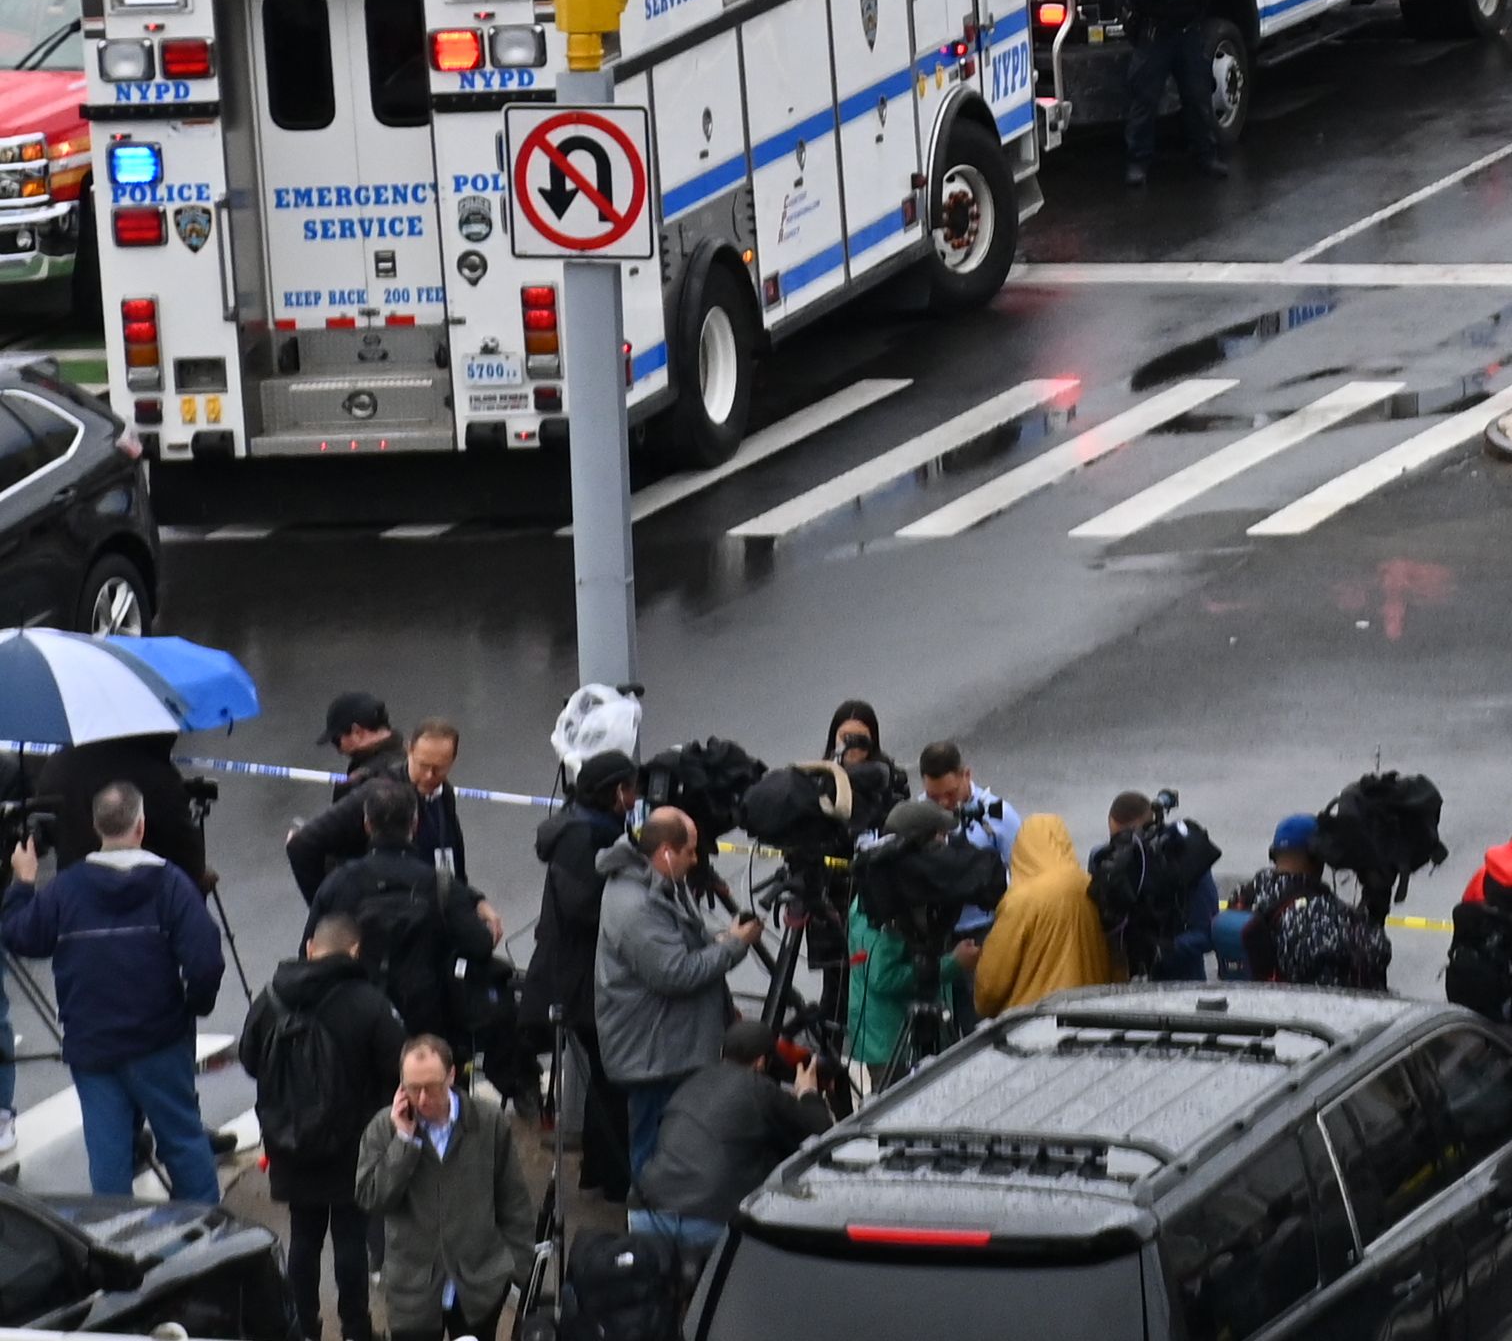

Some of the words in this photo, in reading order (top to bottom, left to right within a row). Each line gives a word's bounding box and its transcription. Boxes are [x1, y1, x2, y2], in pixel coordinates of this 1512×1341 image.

[457, 69, 536, 91] NYPD
[990, 40, 1029, 104] NYPD
[115, 81, 191, 102] NYPD
[111, 181, 211, 205] POLICE
[302, 216, 424, 242] SERVICE
[282, 289, 323, 309] KEEP
[327, 288, 369, 308] BACK
[383, 287, 411, 306] 200
[466, 362, 505, 381] 5700
